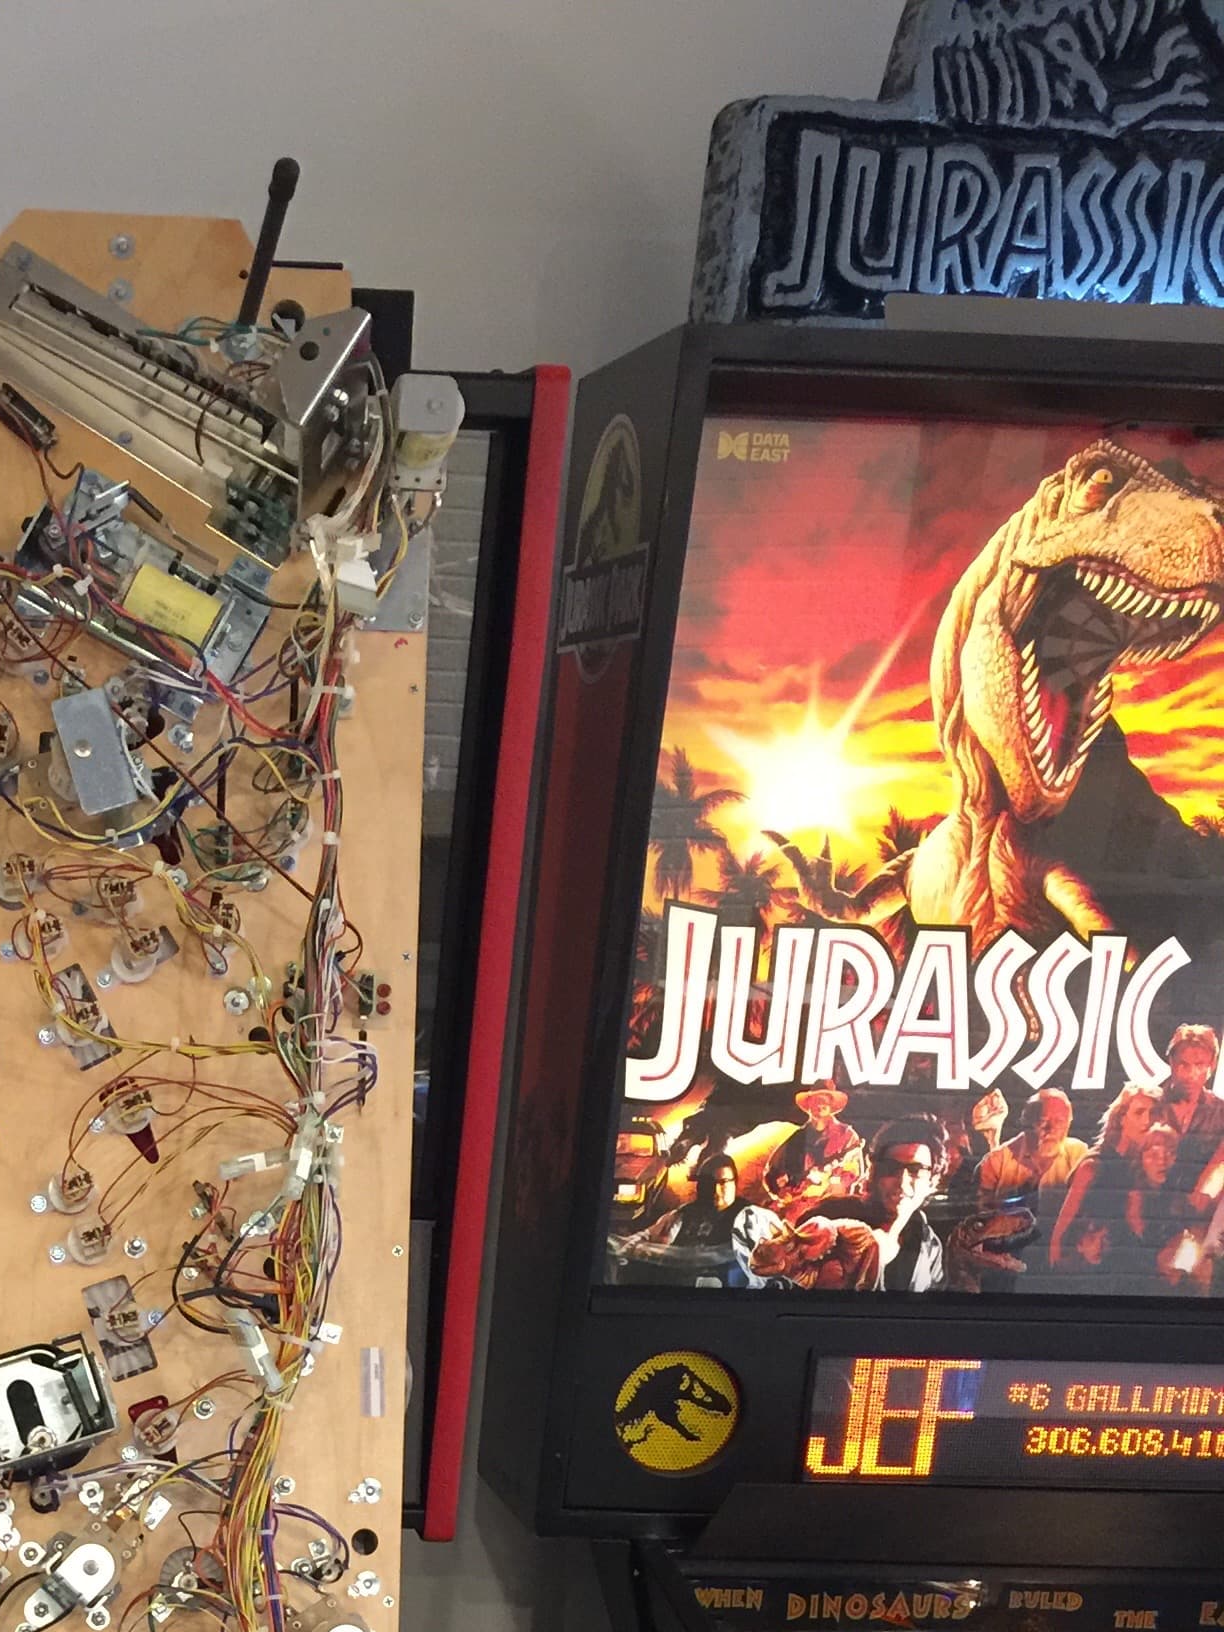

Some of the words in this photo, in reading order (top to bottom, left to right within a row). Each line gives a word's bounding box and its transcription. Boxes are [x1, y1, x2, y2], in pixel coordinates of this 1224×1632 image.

[750, 447, 791, 462] EAST
[752, 432, 790, 447] DATA
[624, 904, 1193, 1102] JURASSIC
[1007, 1382, 1052, 1412] #6
[804, 1357, 982, 1477] JEF
[693, 1585, 765, 1612] WHEN
[785, 1591, 974, 1624] DINOSAURS
[1008, 1589, 1084, 1613] RULED
[1113, 1609, 1159, 1630] THE
